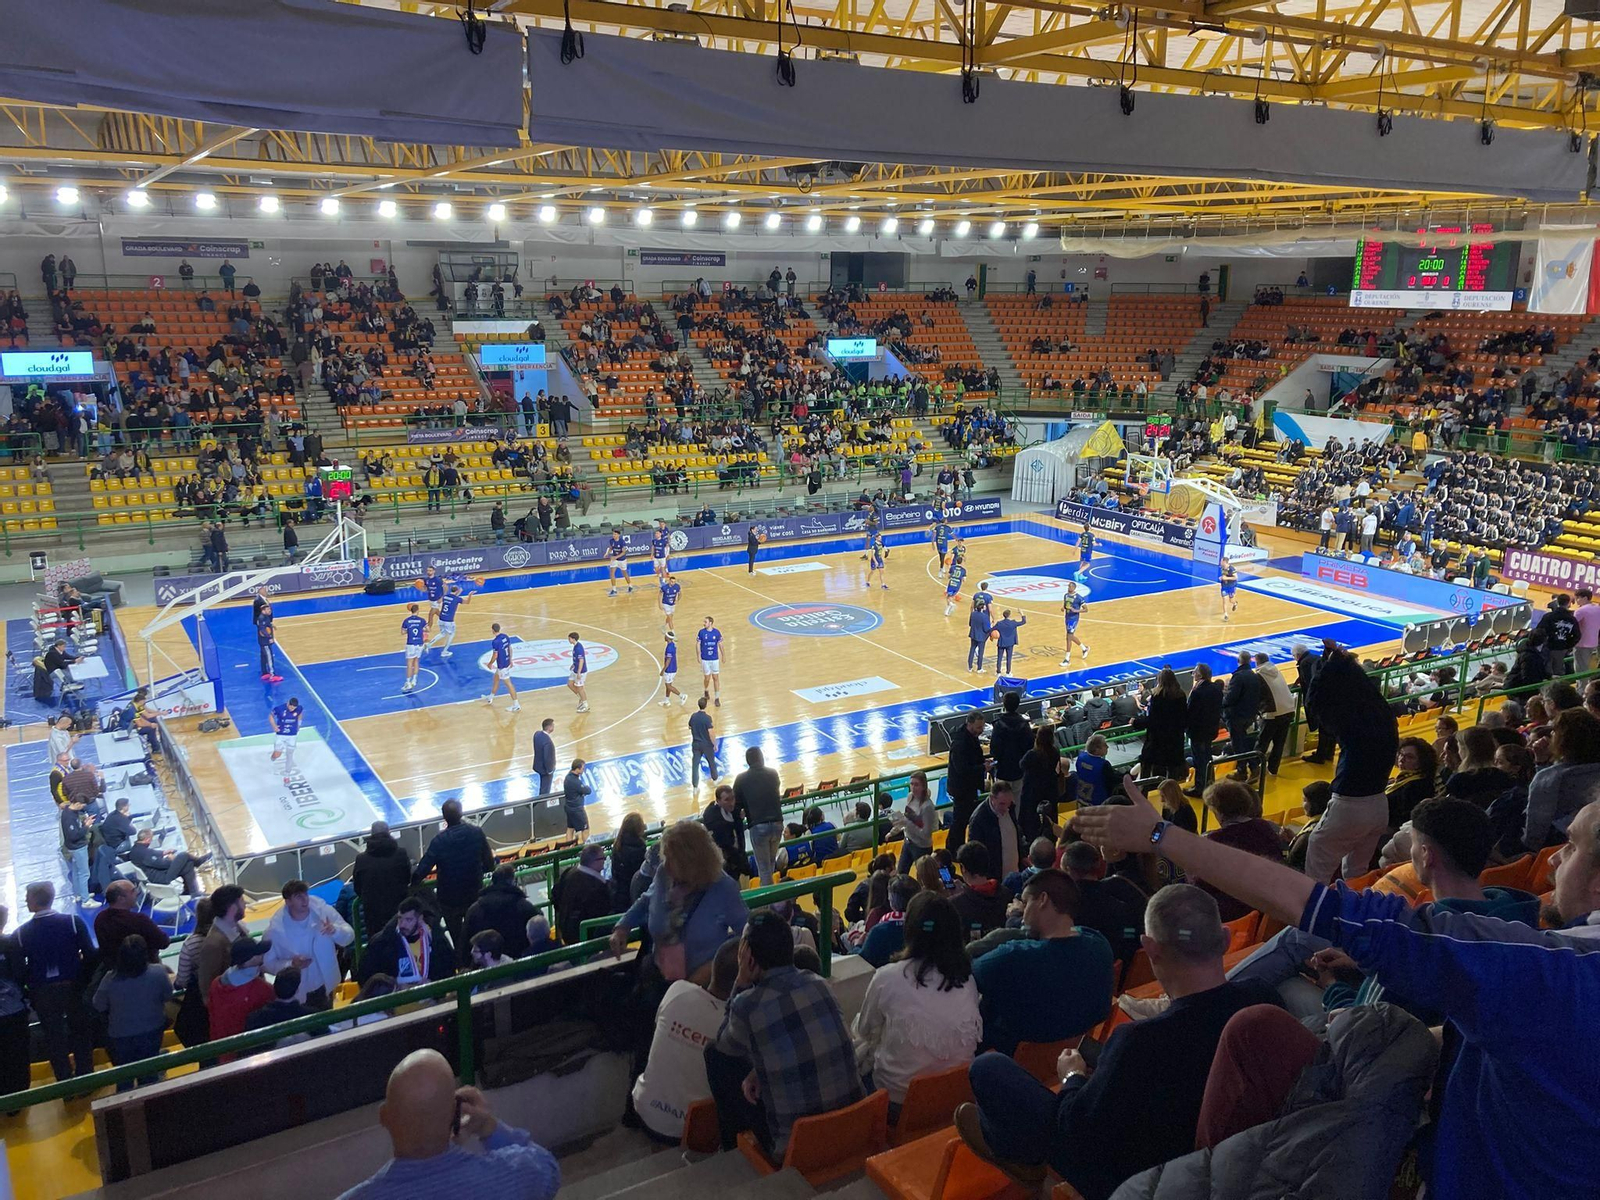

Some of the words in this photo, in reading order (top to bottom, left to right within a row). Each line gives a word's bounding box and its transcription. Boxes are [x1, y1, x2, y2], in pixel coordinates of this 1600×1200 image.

[199, 245, 241, 254] Coinscrap
[692, 255, 720, 263] Coinscrap
[1418, 259, 1445, 270] 20:00
[154, 278, 161, 287] 2
[28, 364, 70, 373] cloud.gal
[465, 428, 499, 436] Coinscrap
[540, 426, 546, 435] 3
[1147, 424, 1159, 435] 24
[1160, 424, 1172, 434] 24
[328, 471, 351, 480] 20:00
[329, 480, 351, 498] 24
[975, 503, 1000, 511] HYUNDAI
[582, 547, 599, 556] mar
[436, 557, 484, 566] BricoCentro
[1510, 551, 1572, 580] CUATRO
[445, 563, 481, 573] Paradelo
[1318, 559, 1370, 576] PRIMERA
[1317, 566, 1369, 588] FEB
[1508, 570, 1559, 586] ESCUELA
[1566, 582, 1580, 590] DE
[777, 609, 842, 622] Galicia
